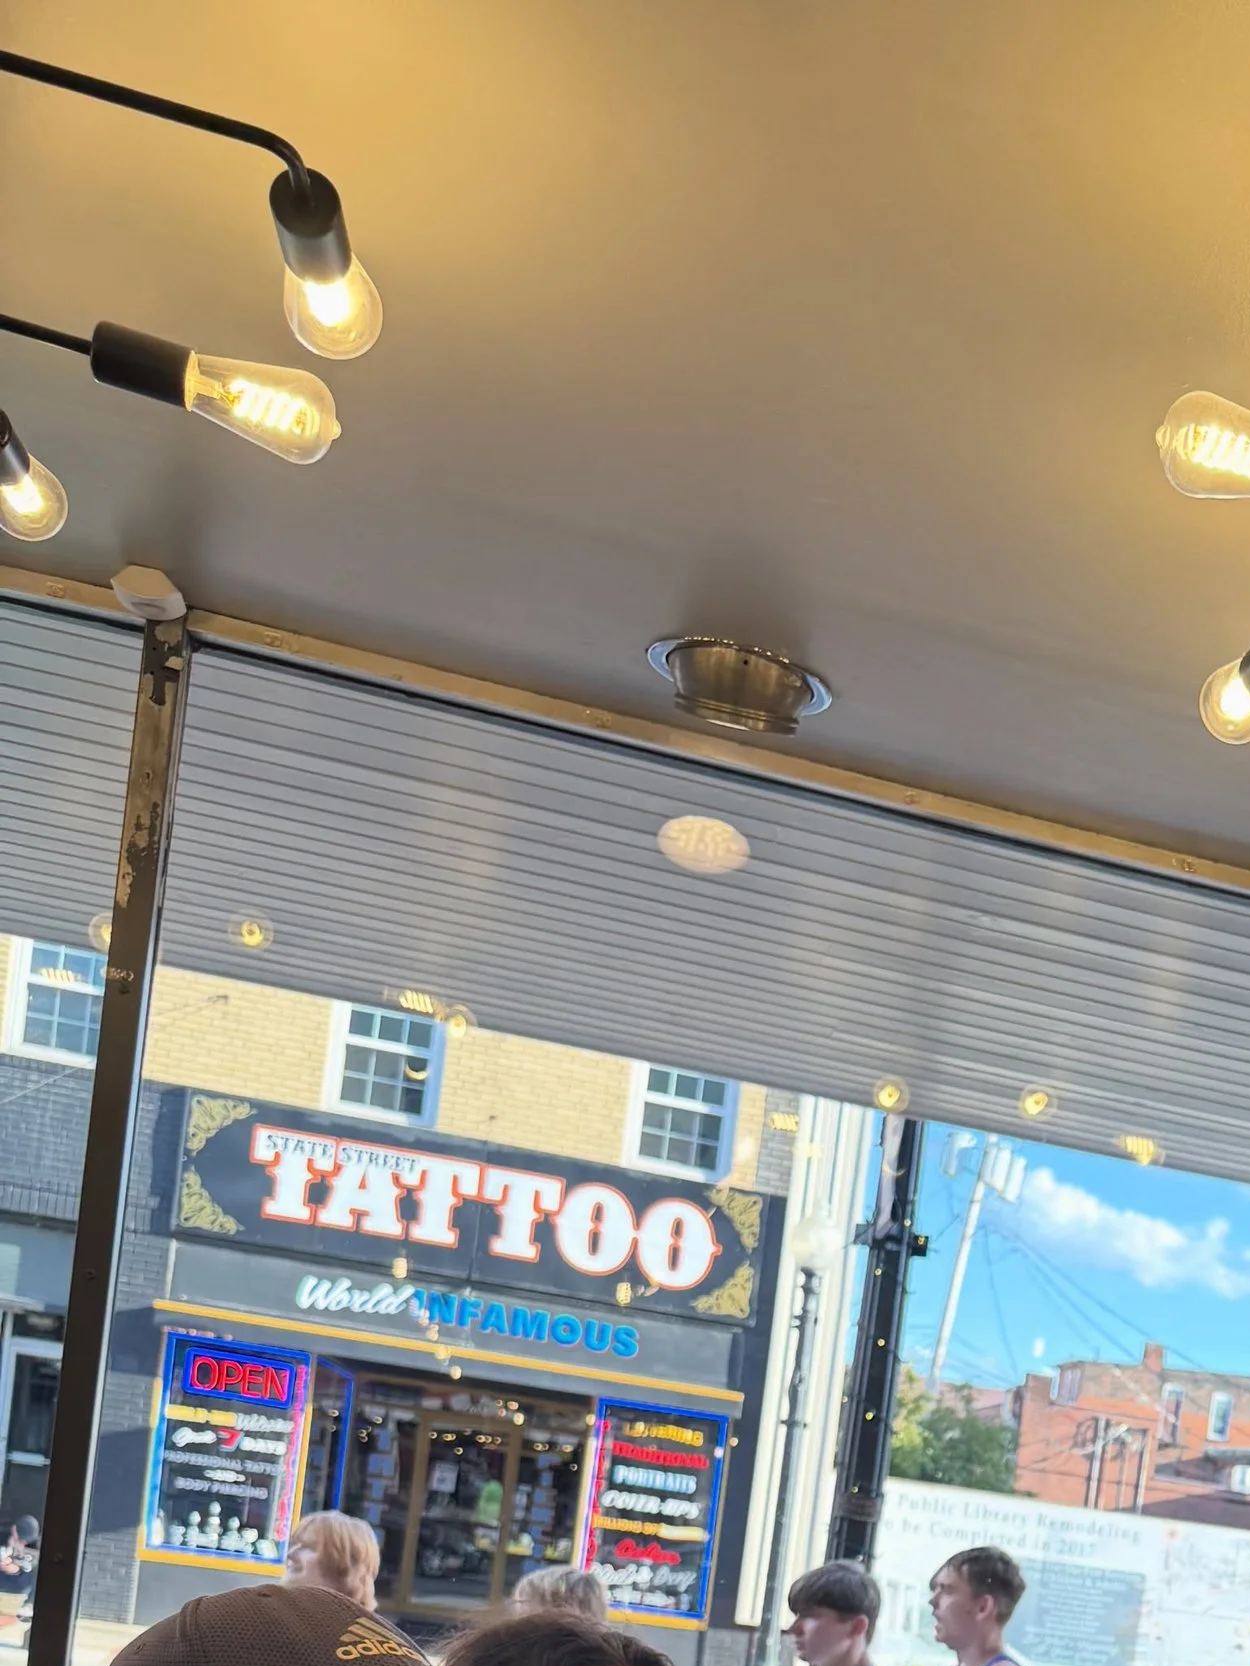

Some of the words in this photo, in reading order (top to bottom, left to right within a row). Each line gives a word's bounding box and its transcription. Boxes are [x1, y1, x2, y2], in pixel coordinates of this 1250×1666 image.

[266, 1134, 335, 1162] STATE
[339, 1145, 420, 1174] STREET
[250, 1122, 723, 1292] TATTOO
[295, 1275, 415, 1315] World
[410, 1287, 640, 1359] INFAMOUS
[191, 1355, 290, 1401] OPEN
[898, 1493, 958, 1520] Public
[962, 1503, 1029, 1529] Library
[1036, 1511, 1144, 1547] Remodeling
[929, 1520, 1028, 1553] Completed
